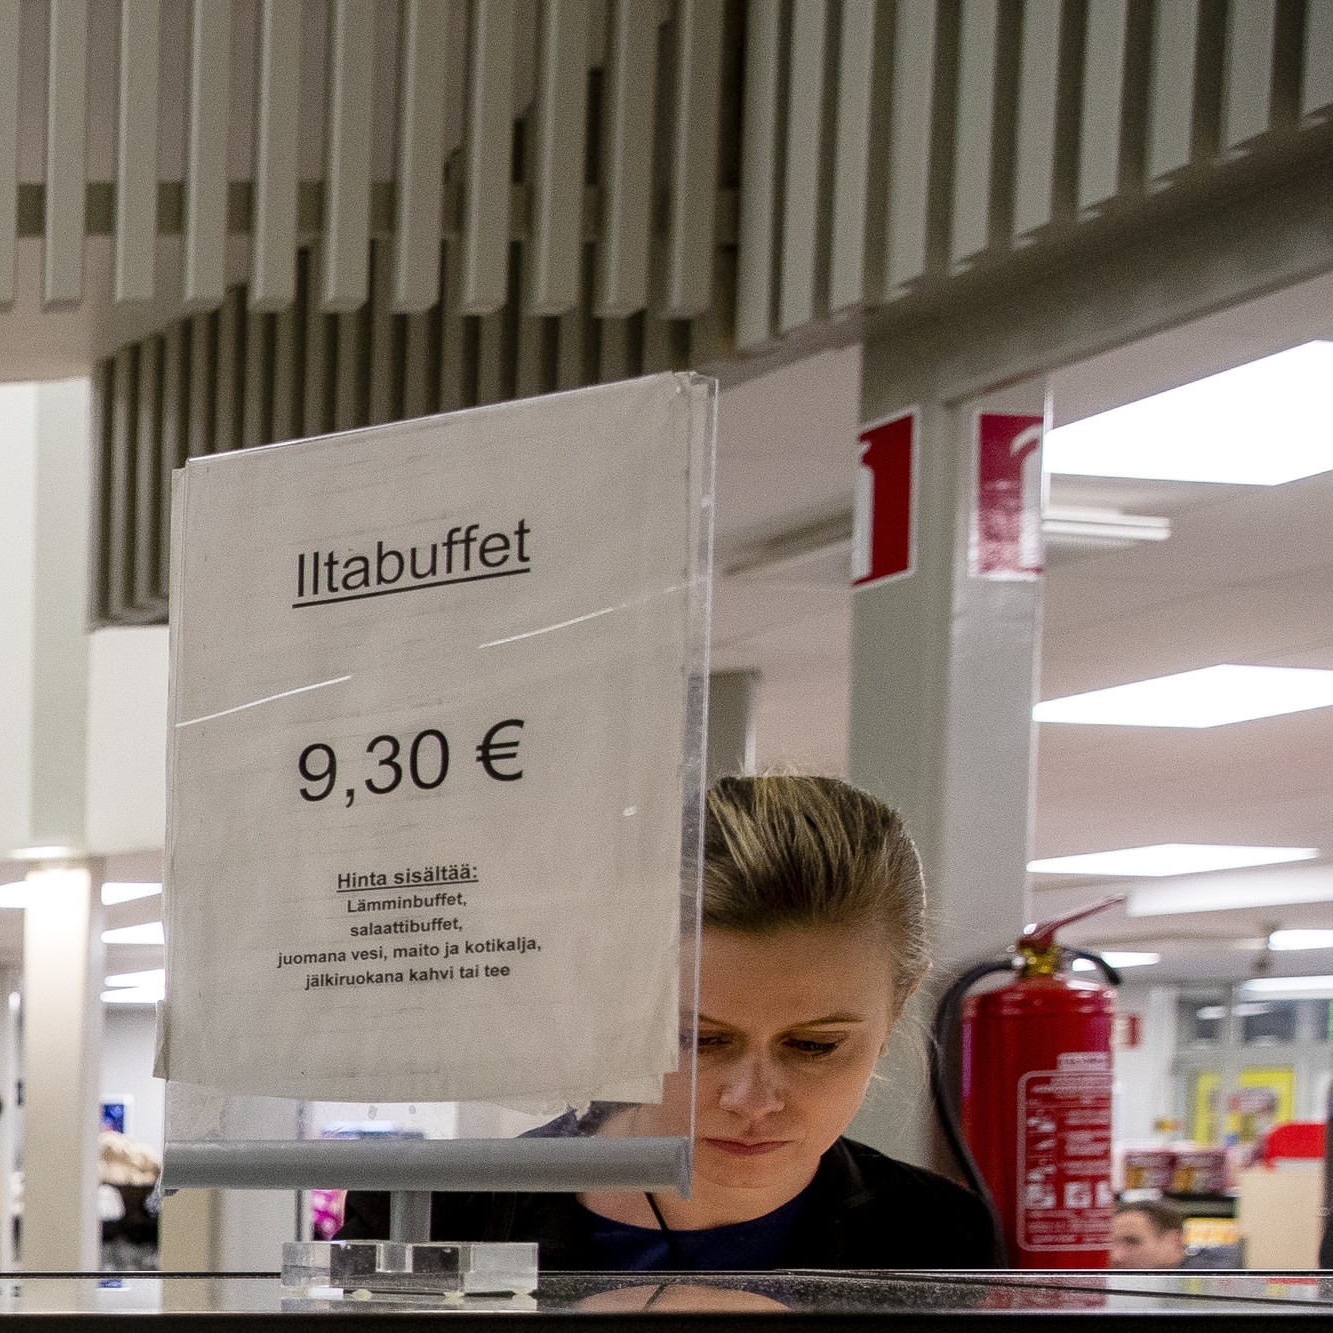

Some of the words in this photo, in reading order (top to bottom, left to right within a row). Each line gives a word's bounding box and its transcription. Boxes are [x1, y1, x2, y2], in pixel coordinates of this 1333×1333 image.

[296, 518, 531, 598] Iltabuffet
[298, 728, 450, 808] 9,30
[475, 718, 525, 782] €
[336, 872, 387, 890] Hinta
[393, 863, 478, 884] sisältää:
[346, 892, 467, 914] Lämminbuffet,
[349, 917, 463, 937] salaattibuffet,
[276, 949, 347, 968] juomana
[351, 946, 388, 962] vesi,
[393, 942, 440, 959] maito
[443, 941, 459, 959] ja
[464, 936, 542, 955] kotikalja,
[304, 970, 404, 990] jälkiruokana
[409, 965, 454, 982] kahvi
[459, 964, 479, 979] tai
[484, 964, 511, 977] tee
